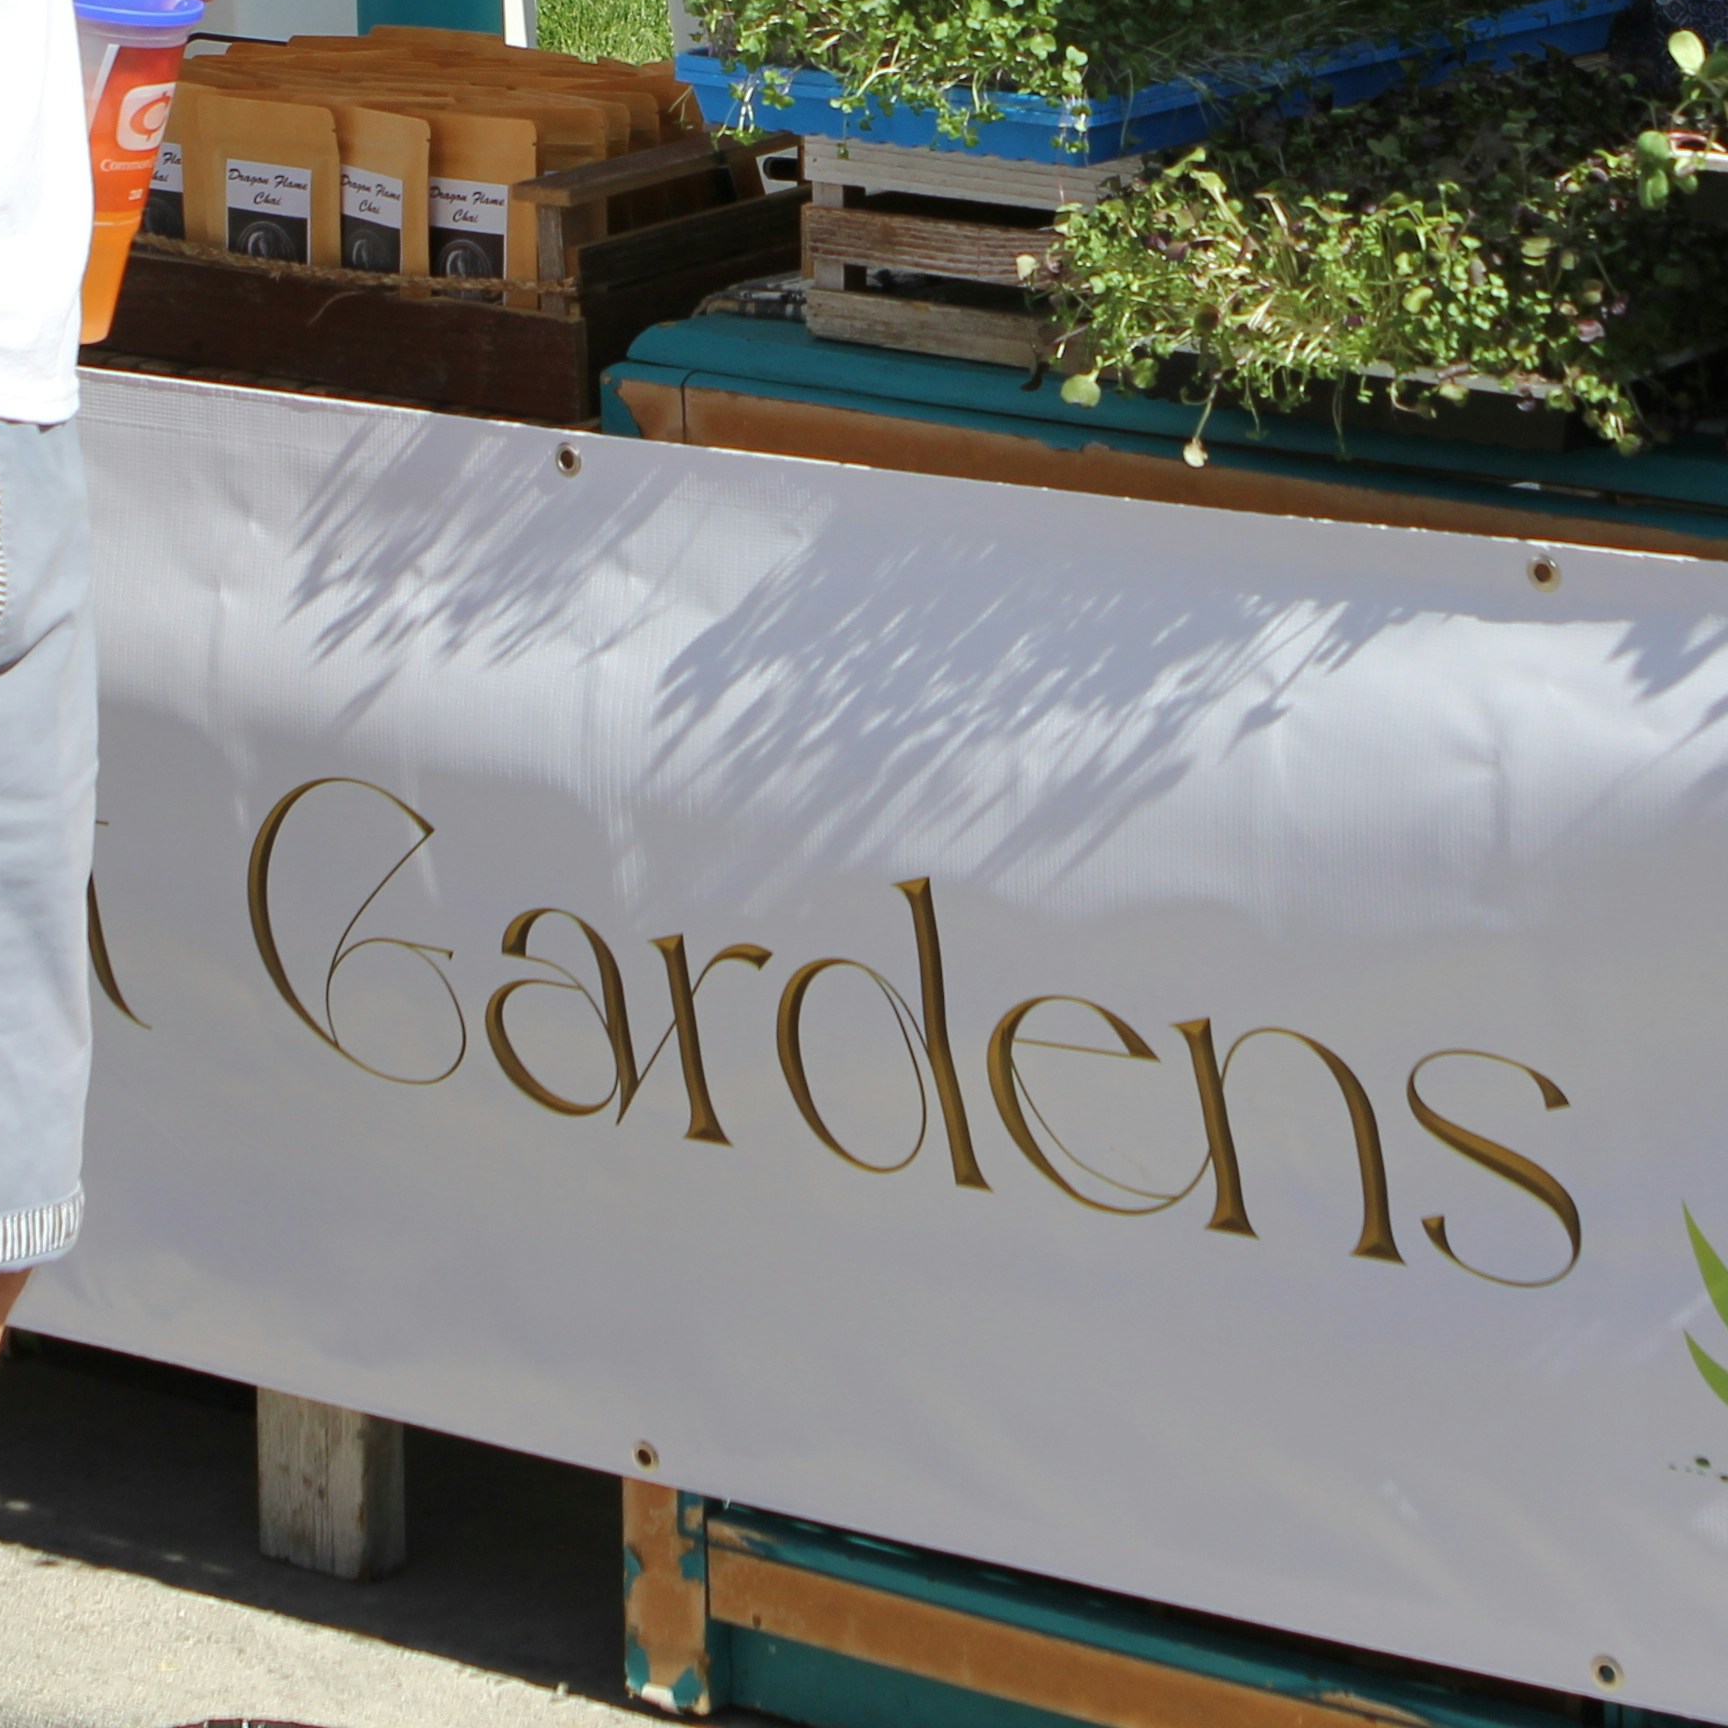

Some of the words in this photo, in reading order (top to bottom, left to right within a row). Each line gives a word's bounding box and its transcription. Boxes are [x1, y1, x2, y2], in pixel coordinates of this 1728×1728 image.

[162, 151, 182, 166] Fla
[229, 168, 270, 187] Dragon
[274, 175, 308, 190] Flame
[341, 174, 372, 193] Dragon
[375, 184, 401, 201] Flame
[253, 191, 282, 206] Chai
[430, 185, 468, 204] Dragon
[473, 191, 505, 206] Flame
[358, 199, 381, 215] Chai
[452, 209, 480, 223] Chai
[247, 777, 1582, 1288] Gardens
